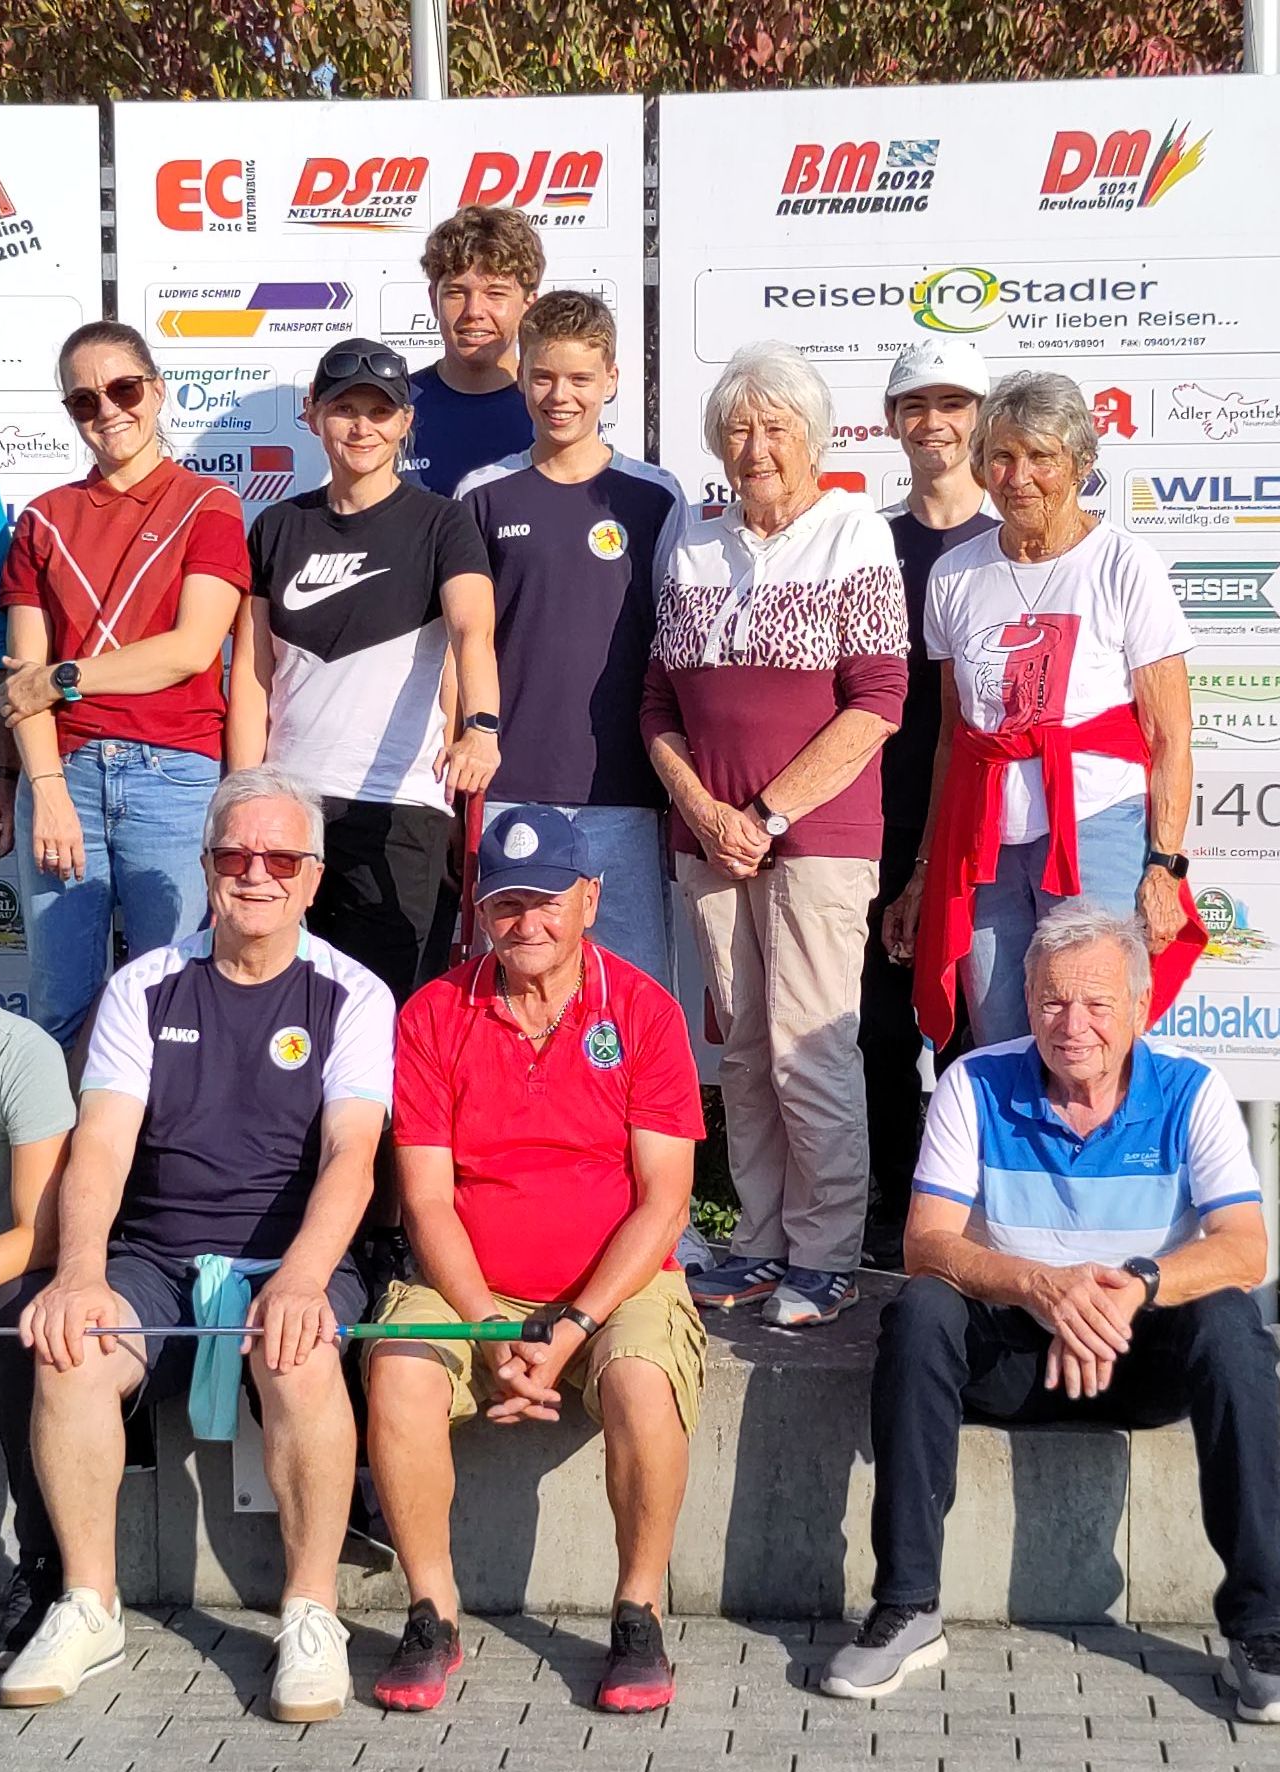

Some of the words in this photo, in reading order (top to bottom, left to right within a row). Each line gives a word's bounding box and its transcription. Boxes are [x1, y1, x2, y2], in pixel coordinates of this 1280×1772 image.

[781, 141, 881, 195] BM
[1039, 129, 1152, 194] DM
[291, 156, 430, 206] DSM
[458, 150, 604, 208] DJM
[877, 170, 936, 191] 2022
[156, 159, 243, 232] EC
[370, 195, 418, 205] 2018
[287, 207, 412, 219] NEUTRAUBLING
[776, 196, 928, 216] NEUTRAUBLING
[209, 223, 242, 232] 2016
[554, 215, 586, 226] 2019
[158, 289, 199, 299] LUDWIG
[201, 289, 241, 299] SCHMID
[763, 281, 982, 308] Reisebüro
[999, 278, 1159, 304] Stadler
[268, 322, 323, 332] TRANSPORT
[1008, 313, 1048, 329] Wir
[1056, 311, 1128, 328] lieben
[848, 344, 859, 352] 13
[162, 367, 271, 385] aumgartner
[1168, 405, 1212, 420] Adler
[170, 418, 252, 430] Neutraubling
[1131, 514, 1230, 527] www.wildkg.de
[497, 523, 531, 540] JAKO
[298, 552, 369, 584] NIKE
[1192, 846, 1226, 857] skills
[158, 1026, 200, 1043] JAKO
